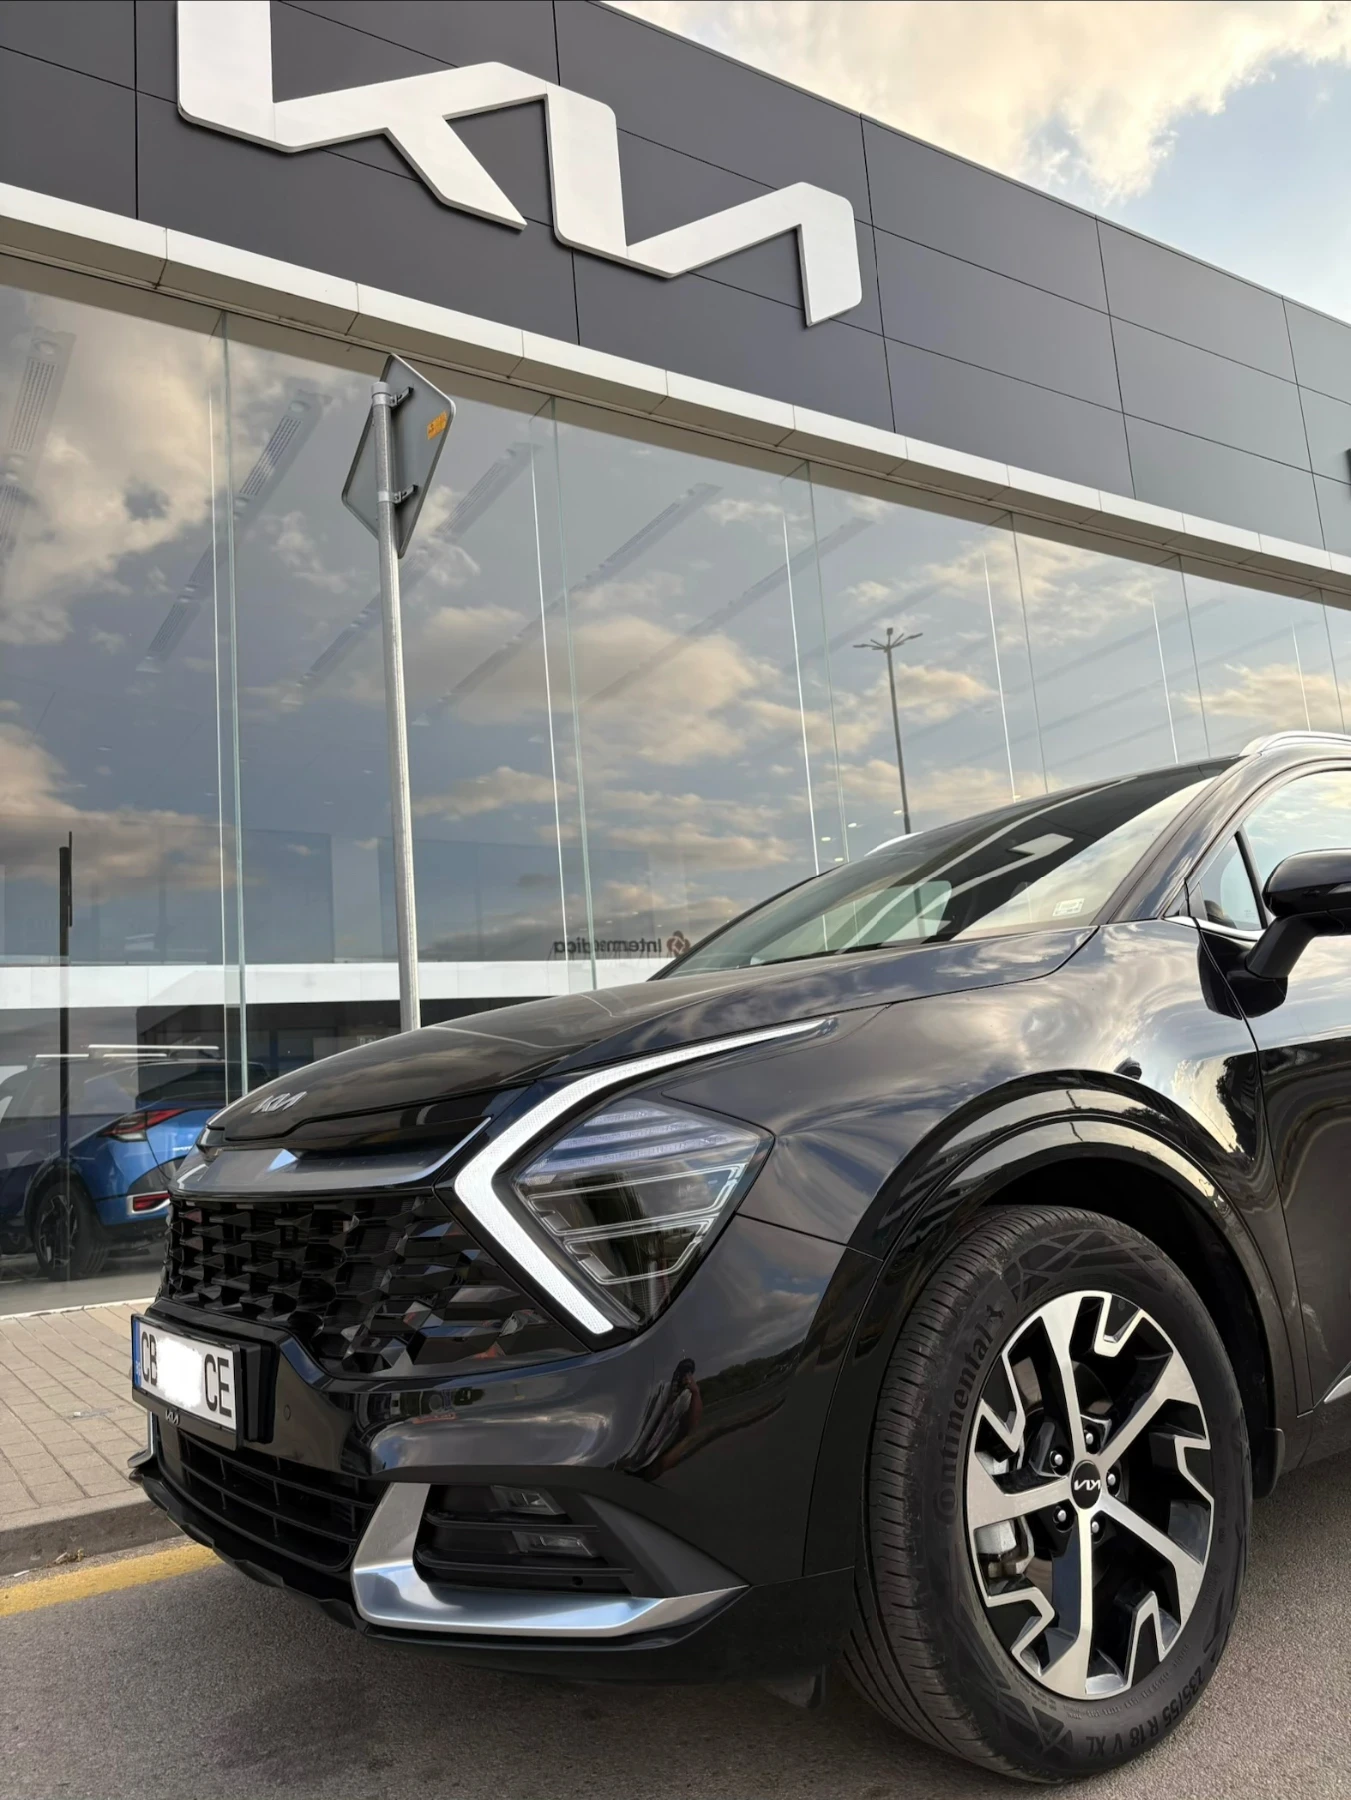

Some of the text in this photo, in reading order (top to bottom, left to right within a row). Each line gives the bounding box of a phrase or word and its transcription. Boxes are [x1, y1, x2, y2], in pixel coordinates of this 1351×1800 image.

[249, 1090, 308, 1114] KIA
[204, 1353, 232, 1418] CE
[1161, 1665, 1205, 1729] 235/55
[1085, 1735, 1106, 1757] XL
